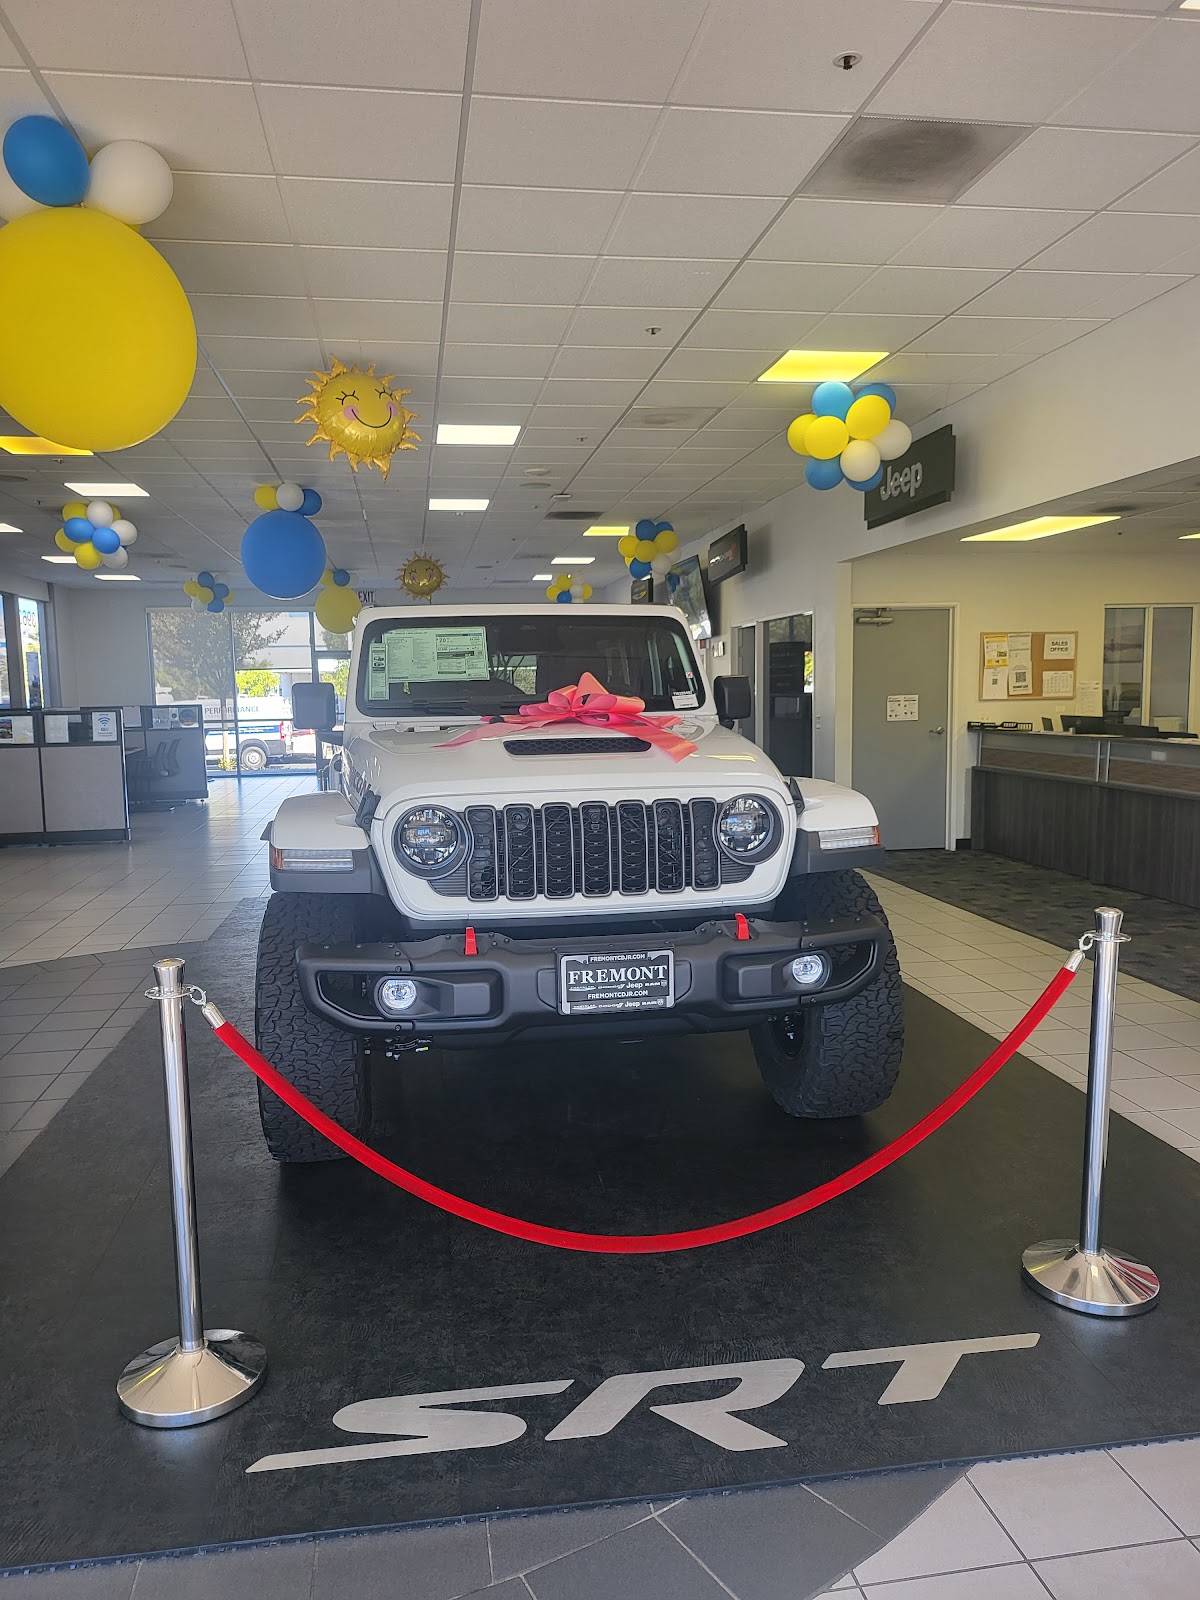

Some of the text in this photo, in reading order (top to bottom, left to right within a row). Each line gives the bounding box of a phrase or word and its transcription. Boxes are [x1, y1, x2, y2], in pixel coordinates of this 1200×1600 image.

[880, 462, 923, 501] Jeep
[590, 954, 645, 962] FREMONTCDJR.COM
[568, 965, 667, 984] FREMONT
[626, 981, 643, 989] Jeep
[588, 990, 648, 999] FREMONTCDJR.COM
[624, 999, 641, 1008] Jeep
[245, 1333, 1041, 1473] SRT
